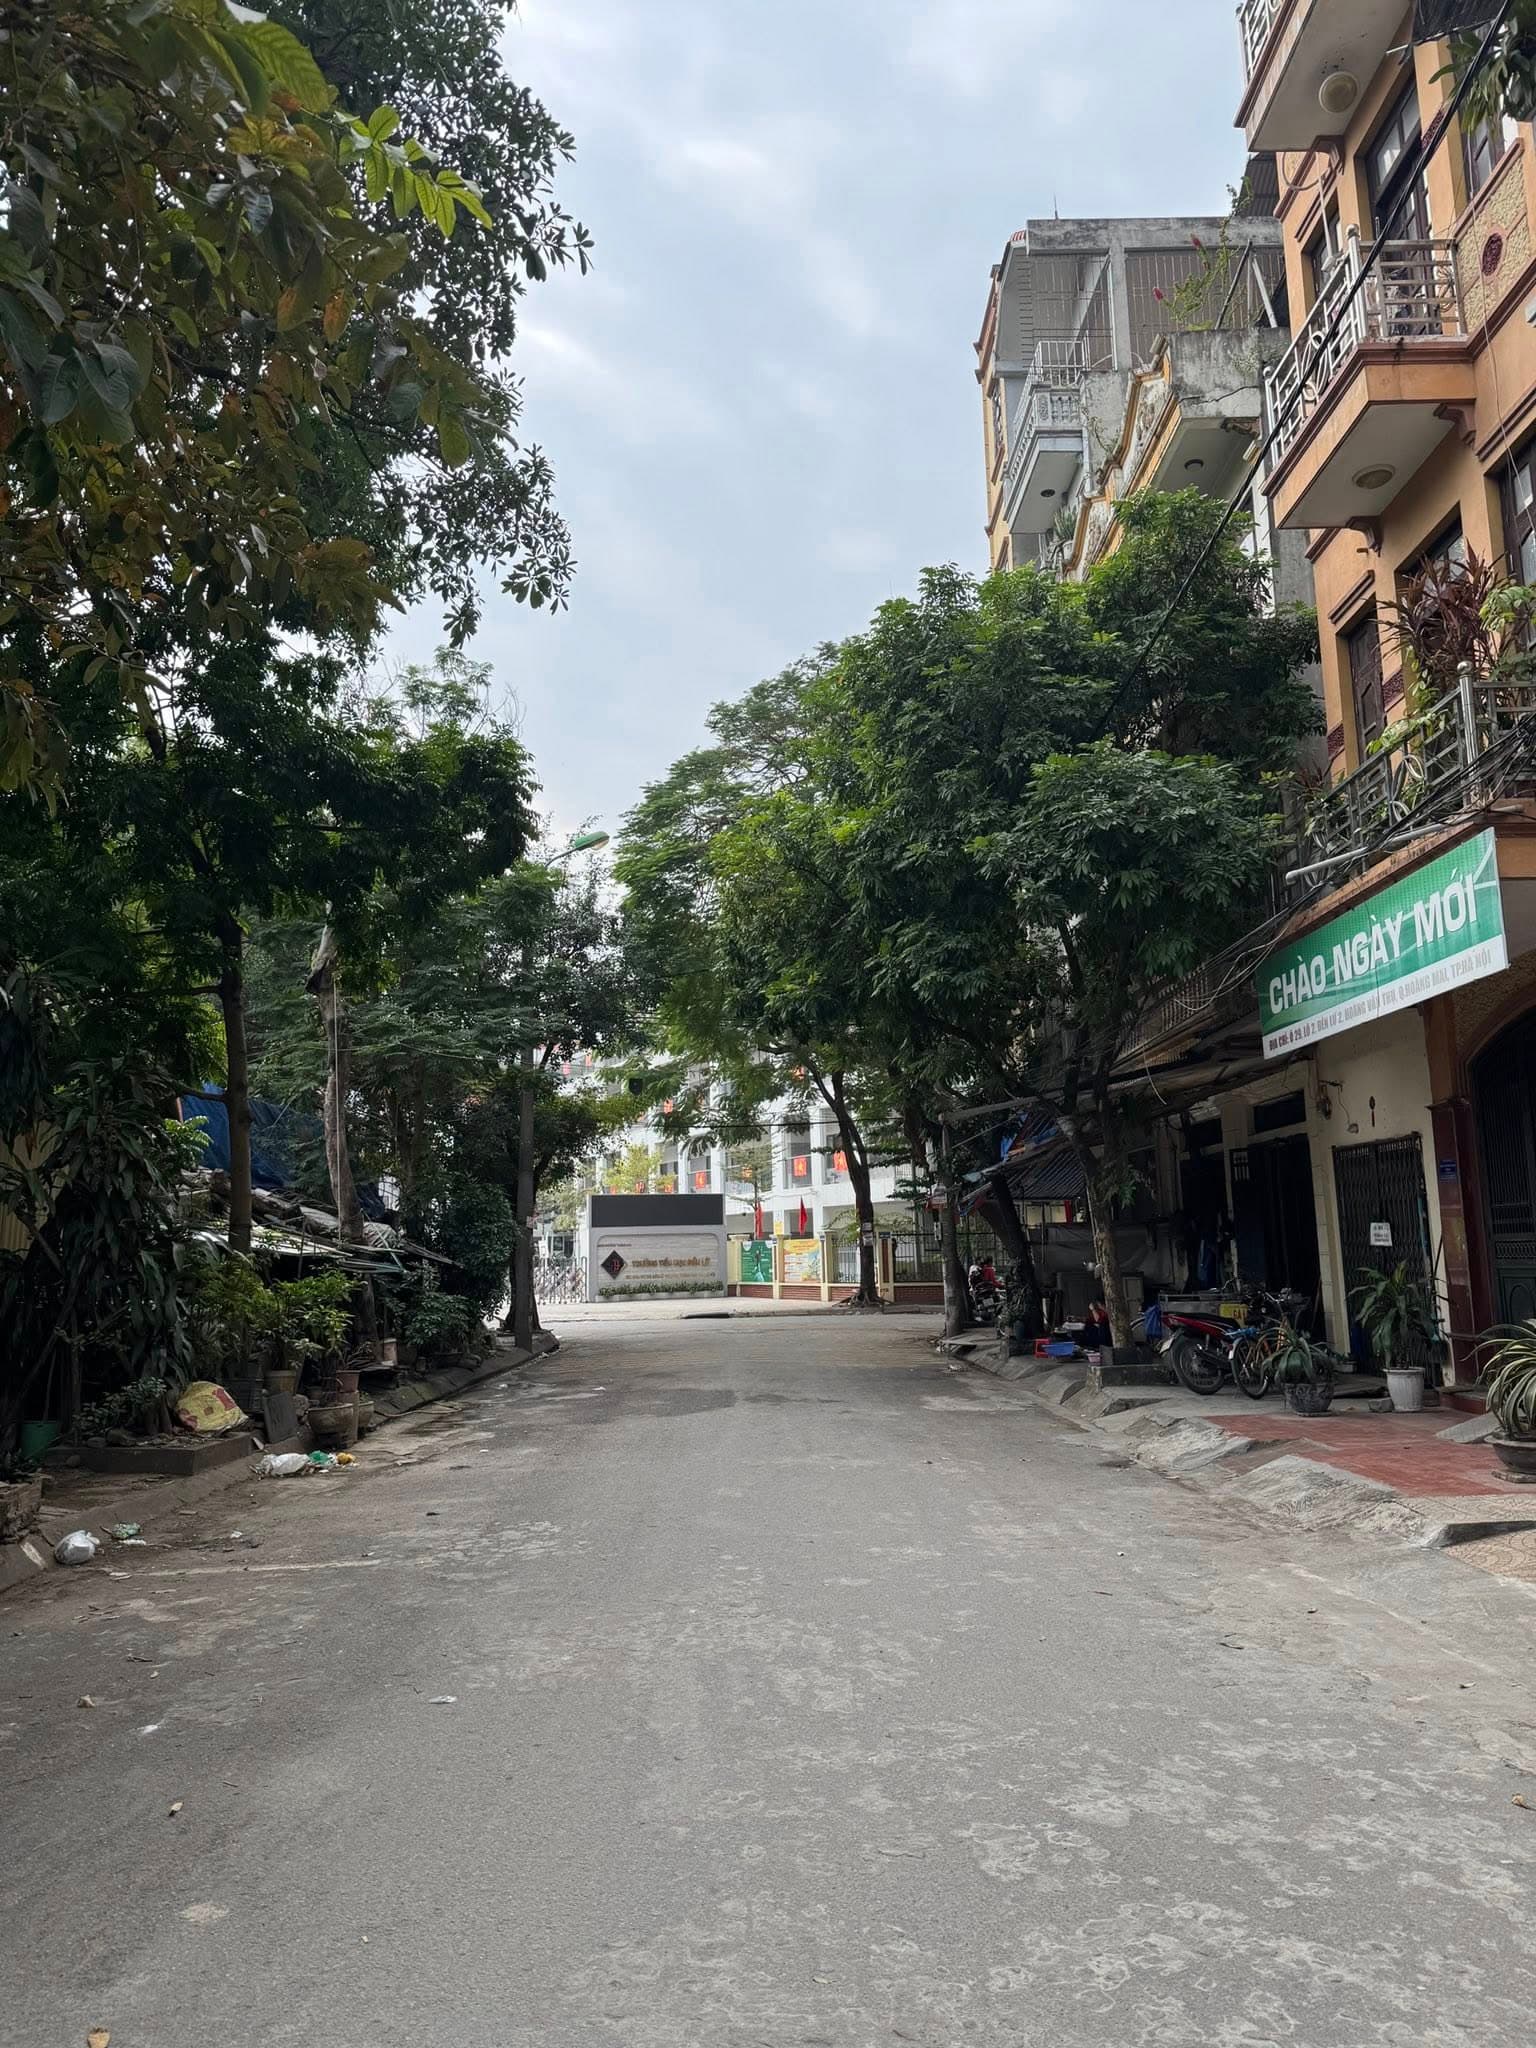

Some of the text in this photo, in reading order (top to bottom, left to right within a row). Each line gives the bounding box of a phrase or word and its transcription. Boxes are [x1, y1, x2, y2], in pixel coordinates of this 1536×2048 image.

[1269, 868, 1477, 1014] CHÀO NGÀY MỚI
